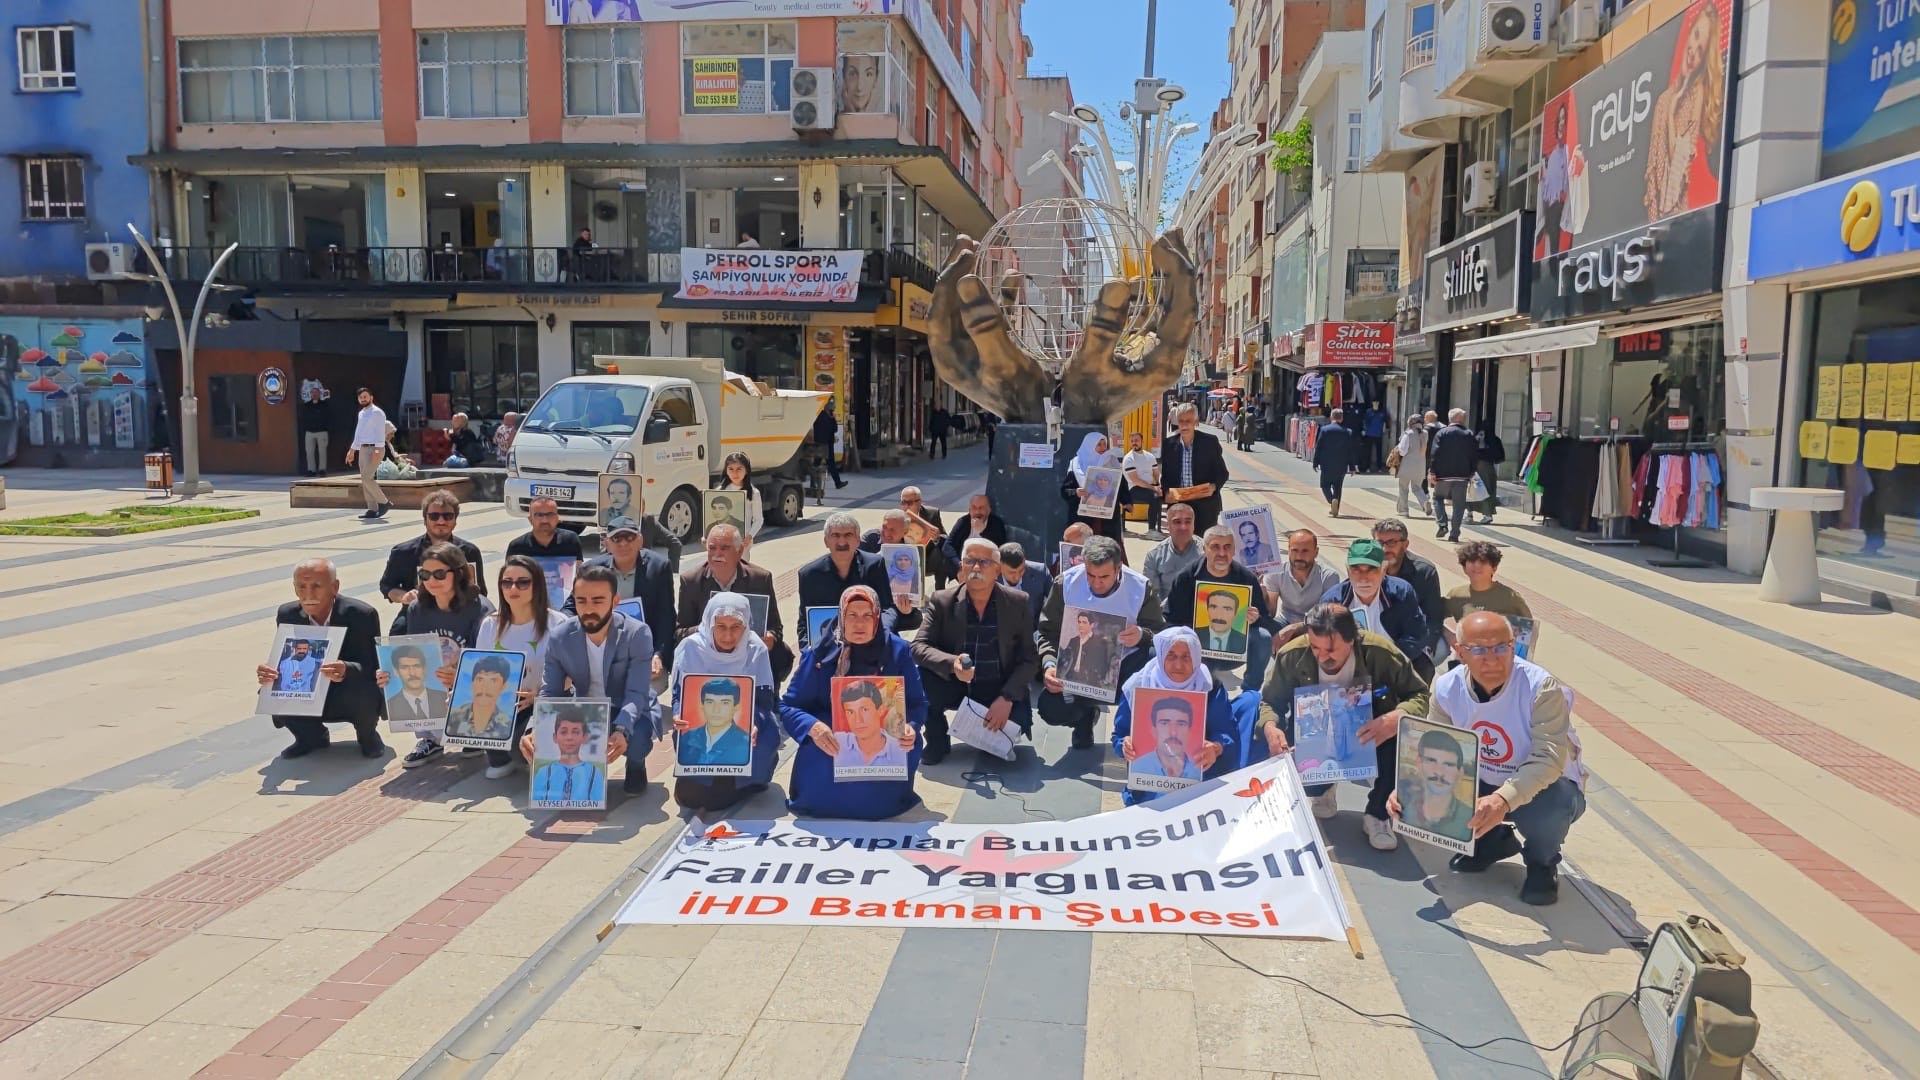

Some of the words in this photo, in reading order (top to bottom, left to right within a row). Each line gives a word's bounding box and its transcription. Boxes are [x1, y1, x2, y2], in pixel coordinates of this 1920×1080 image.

[754, 3, 777, 12] beauty
[815, 2, 842, 10] esthetic
[1533, 3, 1542, 40] BEKO
[695, 61, 736, 73] SAHİBİNDEN
[1589, 71, 1652, 148] rays
[705, 253, 771, 267] PETROL
[692, 270, 786, 283] ŞAMPİYONLUK
[1442, 245, 1486, 301] stilife
[1558, 236, 1648, 302] rays
[1336, 325, 1381, 341] Şirin
[535, 486, 543, 495] 72
[545, 487, 558, 496] ABS
[560, 488, 571, 497] 142
[446, 738, 482, 746] ABDULLAH
[483, 740, 507, 748] BULUT
[1302, 771, 1341, 780] MERYEM
[1343, 767, 1373, 777] BULUT
[537, 800, 563, 808] VEYSEL
[565, 800, 600, 808] ATILGAN
[753, 832, 966, 852] Kayıplar
[1397, 823, 1430, 840] MAHMUT
[1432, 835, 1468, 852] DEMİREL
[660, 858, 891, 886] Failler
[913, 841, 1323, 895] Yargılansın
[678, 890, 789, 916] İHD
[809, 897, 1042, 921] Batman
[1066, 902, 1280, 928] Şubesi
